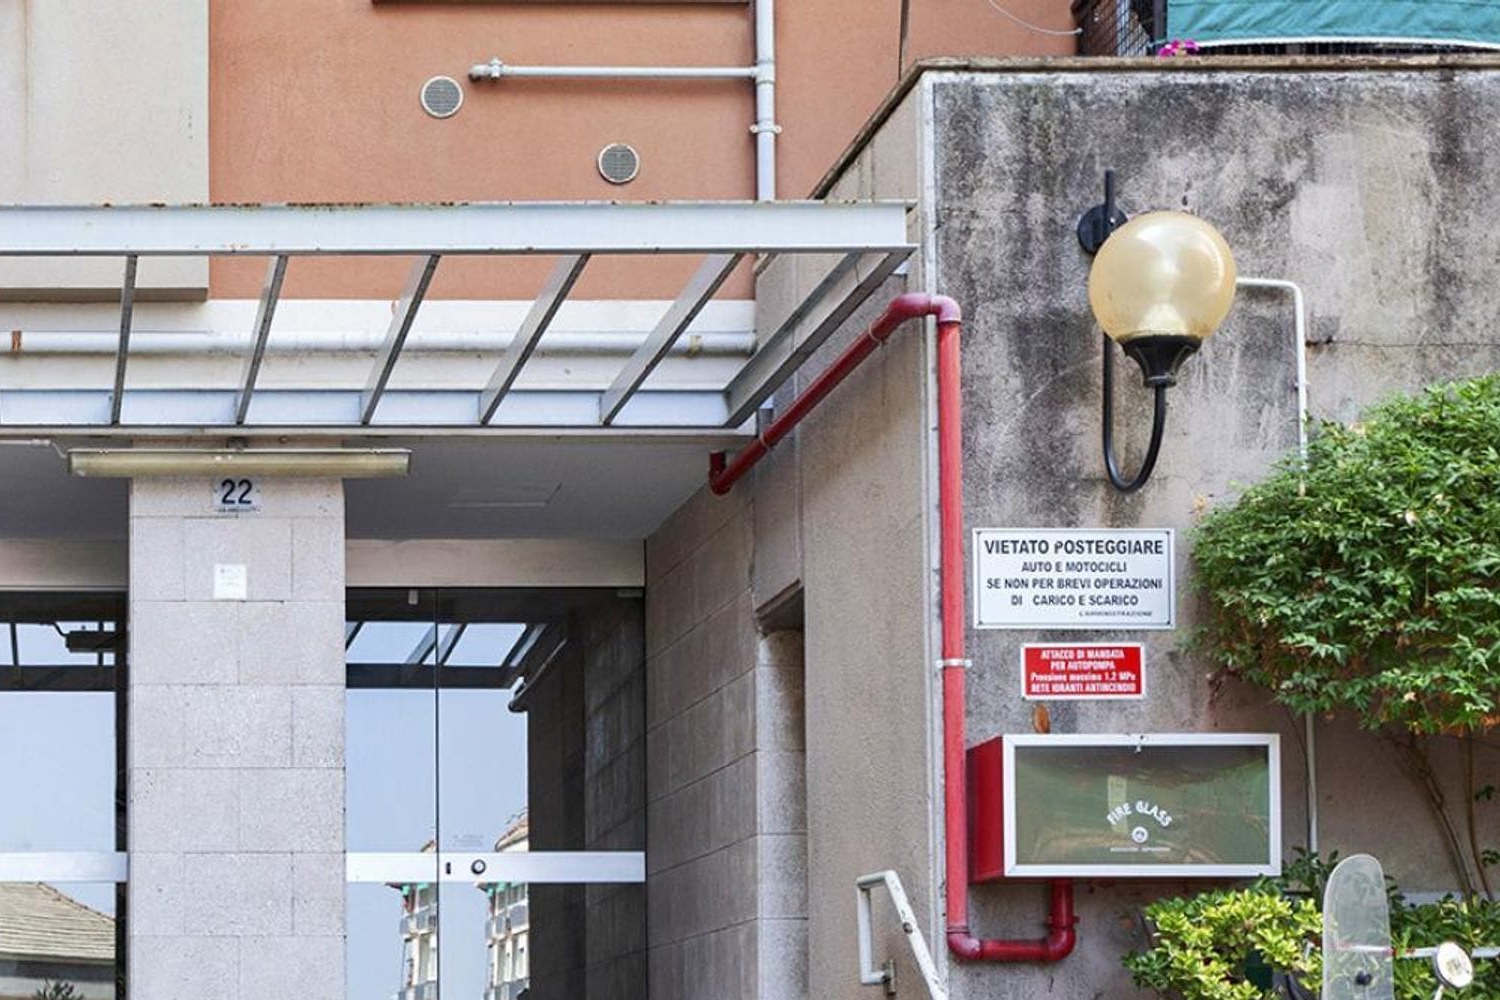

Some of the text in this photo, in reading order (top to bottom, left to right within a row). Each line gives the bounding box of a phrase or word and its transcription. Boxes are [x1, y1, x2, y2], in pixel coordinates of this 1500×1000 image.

[221, 478, 252, 504] 22
[984, 539, 1163, 555] VIETATO POSTEGGIARE
[1021, 561, 1127, 573] AUTO E MOTOCICLI
[987, 578, 1162, 589] SE NON PER BREVI OPERAZIONI
[1011, 595, 1139, 606] DI CARICO E SCARICO
[1041, 649, 1125, 659] ATTACCO DI MANDATA
[1050, 660, 1115, 671] PER AUTOPOMPA
[1031, 682, 1136, 692] RETE IDRANTI ANTINCENDIO
[1106, 799, 1173, 827] FIRE GLASS
